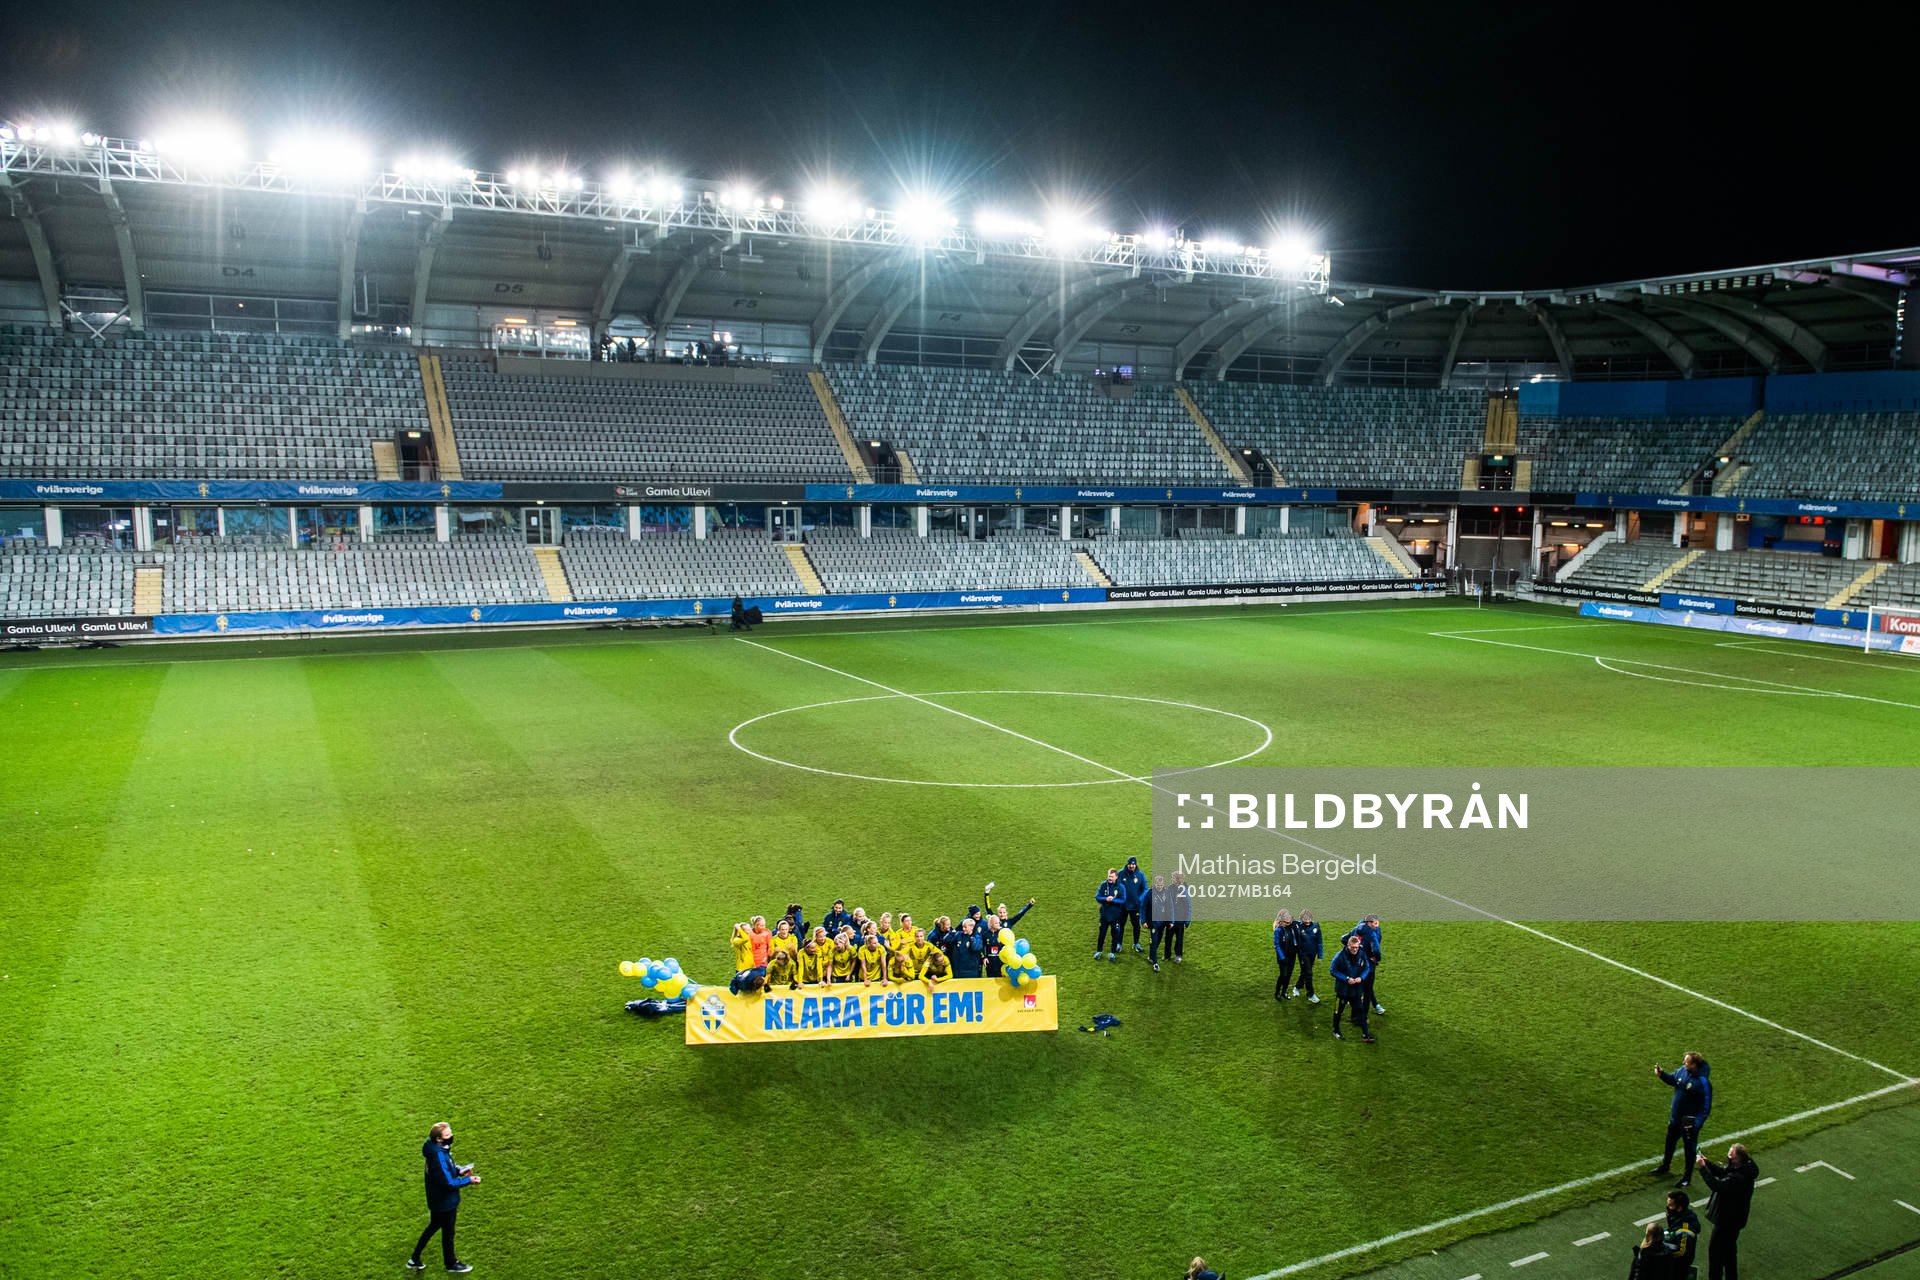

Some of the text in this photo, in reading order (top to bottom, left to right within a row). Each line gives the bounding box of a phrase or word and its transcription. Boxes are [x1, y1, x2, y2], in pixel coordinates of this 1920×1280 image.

[495, 283, 524, 293] D5
[733, 299, 757, 308] F5
[36, 485, 104, 495] #viärsverige
[298, 485, 359, 496] #viärsverige
[645, 487, 680, 496] Gamla
[681, 487, 711, 496] Ullevi
[1736, 604, 1756, 614] Gamla
[1757, 606, 1774, 615] Ullevi
[1776, 608, 1797, 617] Gamla
[7, 622, 148, 634] Gamla Ullevi Gamla Ullevi
[764, 991, 983, 1030] KLARA FÖR EM!
